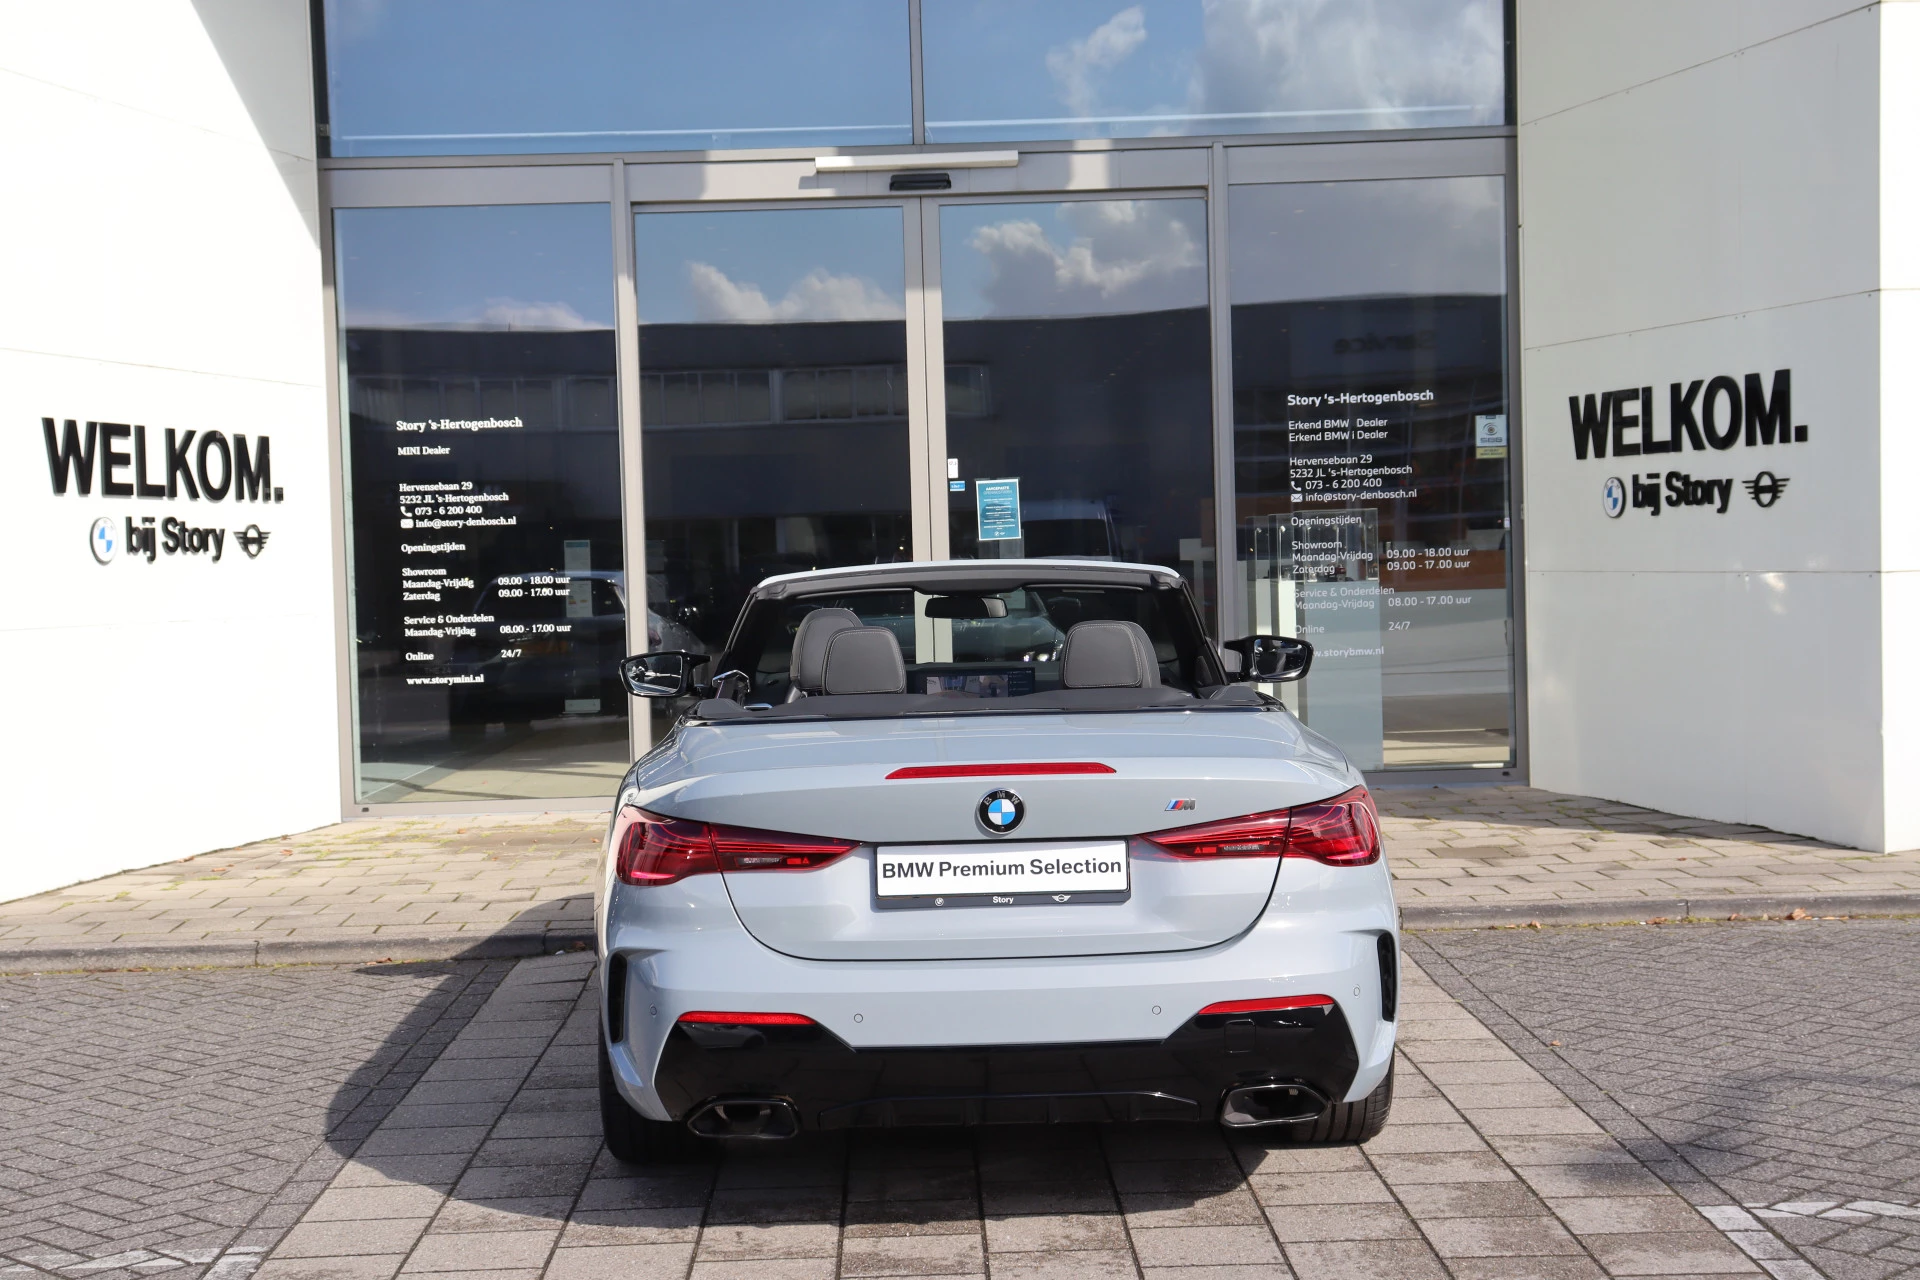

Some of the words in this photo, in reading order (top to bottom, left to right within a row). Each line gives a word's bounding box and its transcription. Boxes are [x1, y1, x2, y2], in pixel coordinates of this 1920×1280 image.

[1287, 394, 1321, 407] Story
[1324, 390, 1434, 405] 's-Hertogenbosch
[1568, 368, 1808, 460] WELKOM.
[396, 420, 426, 433] Story
[428, 417, 523, 431] 's-Hertogenbosch
[1288, 420, 1321, 430] Erkend
[1324, 419, 1349, 429] BMW
[1356, 418, 1388, 428] Dealer
[1289, 432, 1322, 442] Erkend
[1324, 431, 1350, 441] BMW
[1352, 431, 1355, 440] i
[1357, 430, 1388, 440] Dealer
[397, 446, 420, 456] MINI
[422, 445, 450, 455] Dealer
[41, 417, 284, 503] WELKOM.
[1289, 456, 1358, 467] Hervensebaan
[1360, 454, 1373, 464] 29
[1290, 468, 1314, 479] 5232
[1315, 468, 1326, 478] JL
[1328, 465, 1412, 478] 's-Hertogenbosch
[399, 481, 460, 492] Hervensebaan
[461, 481, 473, 491] 29
[1305, 480, 1323, 490] 073
[1332, 479, 1339, 489] 6
[1340, 479, 1360, 489] 200
[1362, 478, 1382, 488] 400
[400, 495, 422, 504] 5232
[423, 494, 434, 504] JL
[436, 492, 509, 505] 's-Hertogenbosch
[1305, 489, 1417, 503] info@story-denbosch.nl
[1632, 472, 1660, 516] bij
[1665, 471, 1733, 514] Story
[415, 506, 432, 516] 073
[439, 506, 446, 515] 6
[447, 506, 464, 515] 200
[465, 505, 482, 515] 400
[415, 516, 517, 530] info@story-denbosch.nl
[1291, 515, 1362, 528] Openingstijden
[125, 516, 156, 564] bij
[161, 516, 225, 564] Story
[1291, 540, 1342, 550] Showroom
[401, 542, 466, 554] Openingstijden
[1292, 551, 1373, 563] Maandag-Vrijdag
[1386, 549, 1415, 559] 09.00
[1425, 547, 1452, 557] 18.00
[1454, 548, 1470, 556] uur
[402, 567, 447, 577] Showroom
[1292, 564, 1335, 575] Zaterdag
[1387, 561, 1416, 571] 09.00
[1455, 560, 1470, 568] uur
[403, 578, 474, 589] Maandag-Vrijdag
[498, 577, 523, 586] 09.00
[530, 576, 553, 585] 18.00
[555, 576, 570, 584] uur
[403, 591, 441, 602] Zaterdag
[498, 589, 523, 598] 09.00
[530, 588, 553, 597] 17.00
[555, 588, 570, 596] uur
[1294, 588, 1328, 598] Service
[1330, 587, 1338, 597] &
[1340, 586, 1394, 597] Onderdelen
[1295, 600, 1375, 612] Maandag-Vrijdag
[1388, 597, 1418, 607] 08.00
[1455, 596, 1472, 605] uur
[404, 616, 436, 625] Service
[437, 615, 444, 624] &
[446, 614, 494, 624] Onderdelen
[404, 627, 476, 638] Maandag-Vrijdag
[500, 625, 524, 634] 08.00
[532, 624, 555, 633] 17.00
[556, 624, 572, 632] uur
[1295, 624, 1325, 634] Online
[1388, 621, 1411, 631] 24/7
[405, 651, 434, 661] Online
[501, 649, 522, 658] 24/7
[1314, 646, 1384, 658] w.storybmw.nl
[406, 674, 484, 685] www.storymini.nl
[983, 791, 1020, 805] BMW
[882, 861, 934, 879] BMW
[939, 859, 1025, 877] Premium
[1029, 857, 1121, 875] Selection
[992, 895, 1014, 904] Story
